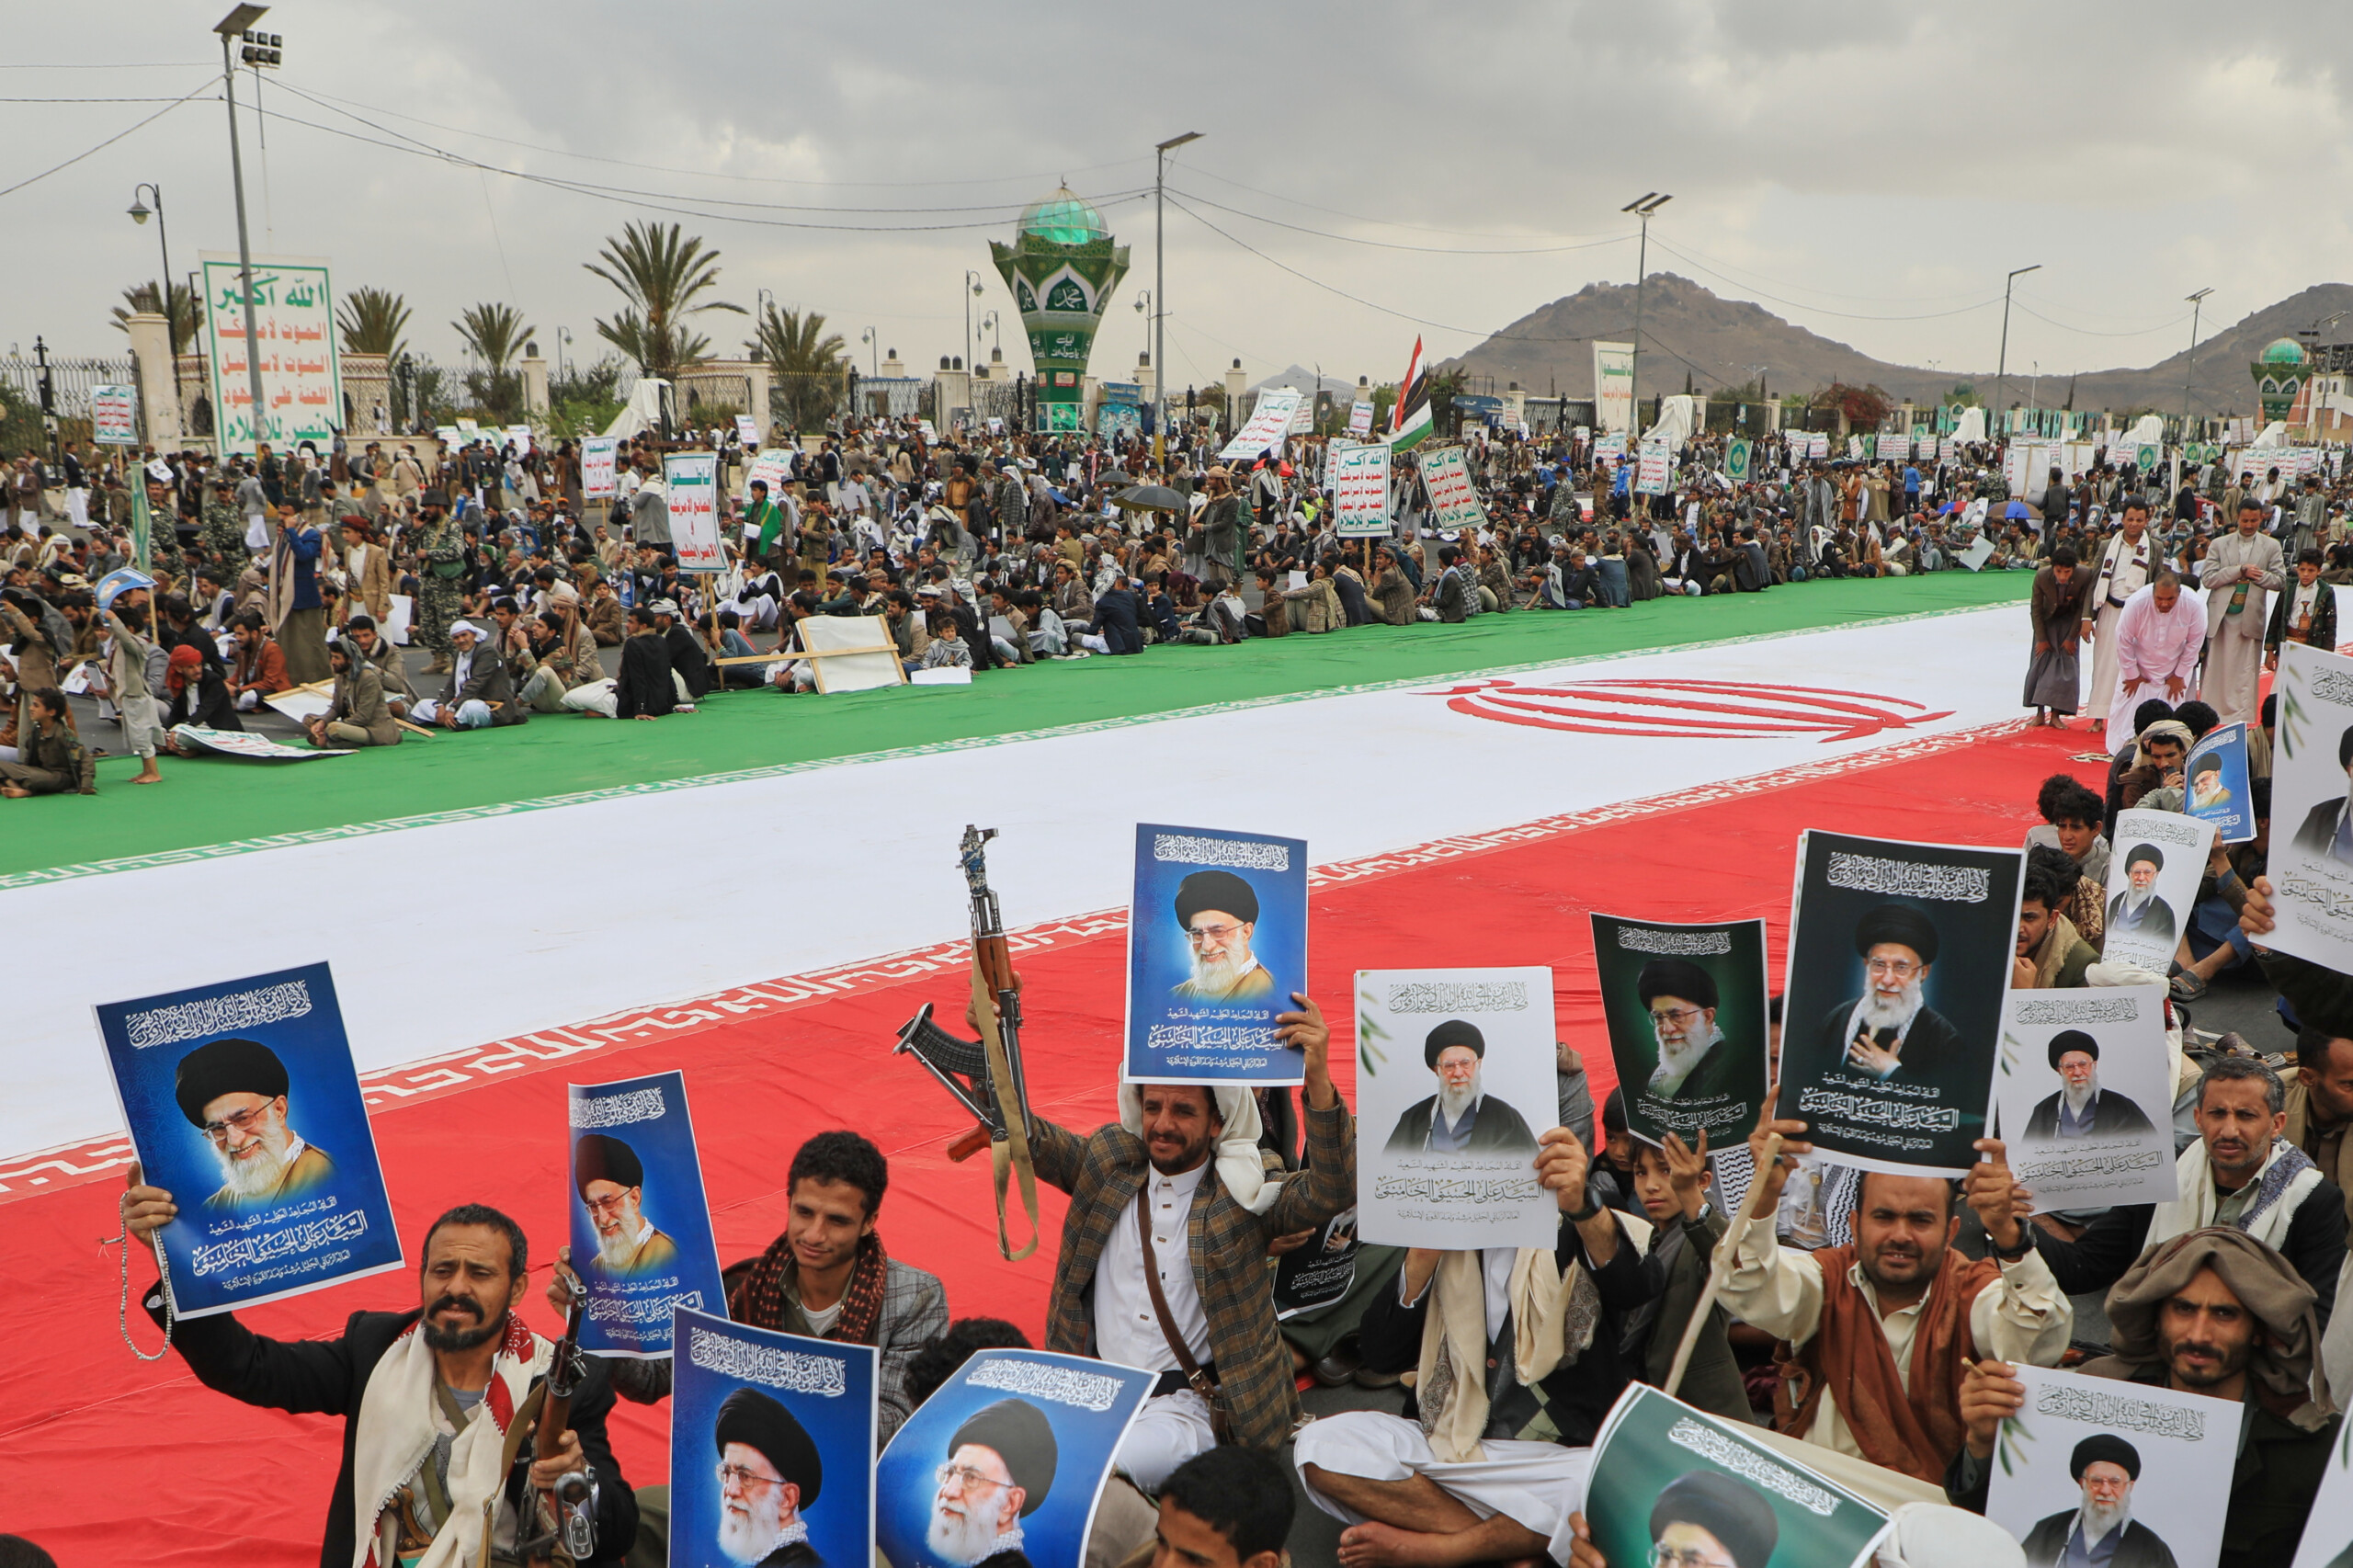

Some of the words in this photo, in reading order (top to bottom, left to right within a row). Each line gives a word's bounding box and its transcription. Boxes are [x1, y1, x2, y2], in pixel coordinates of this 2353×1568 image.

[285, 278, 324, 308] الله
[217, 314, 276, 344] لأميكا
[281, 321, 326, 345] الموت
[284, 354, 330, 378] الموت
[271, 385, 292, 410] على
[299, 384, 333, 405] اللعنة
[1341, 450, 1369, 469] أكبر
[1370, 451, 1386, 465] الله
[1426, 450, 1446, 472] أكبر
[1449, 447, 1463, 464] الله
[669, 466, 711, 490] قاطعوا
[1366, 471, 1385, 482] الموت
[1449, 467, 1464, 479] الموت
[1366, 487, 1385, 498] الموت
[1454, 481, 1469, 493] الموت
[1369, 499, 1385, 508] اللعنة
[1463, 506, 1479, 521] النصر
[1366, 512, 1386, 528] النصر
[1148, 1024, 1197, 1049] الخامنئي
[1195, 1025, 1231, 1051] الحسيني
[1229, 1027, 1259, 1051] علي
[1799, 1086, 1854, 1118] الخامنئي
[1847, 1096, 1893, 1125] الحسيني
[1889, 1102, 1924, 1129] علي
[1912, 1106, 1960, 1132] السيد
[2065, 1158, 2104, 1178] الحسيني
[2103, 1154, 2130, 1175] علي
[2120, 1150, 2164, 1172] السيد
[1375, 1176, 1431, 1201] الخامنئي
[1428, 1178, 1476, 1203] الحسيني
[1474, 1179, 1506, 1204] علي
[1495, 1178, 1545, 1203] السيد
[296, 1219, 328, 1253] علي
[318, 1209, 369, 1246] السيد
[192, 1236, 256, 1277] الخامنئي
[254, 1227, 298, 1264] الحسيني
